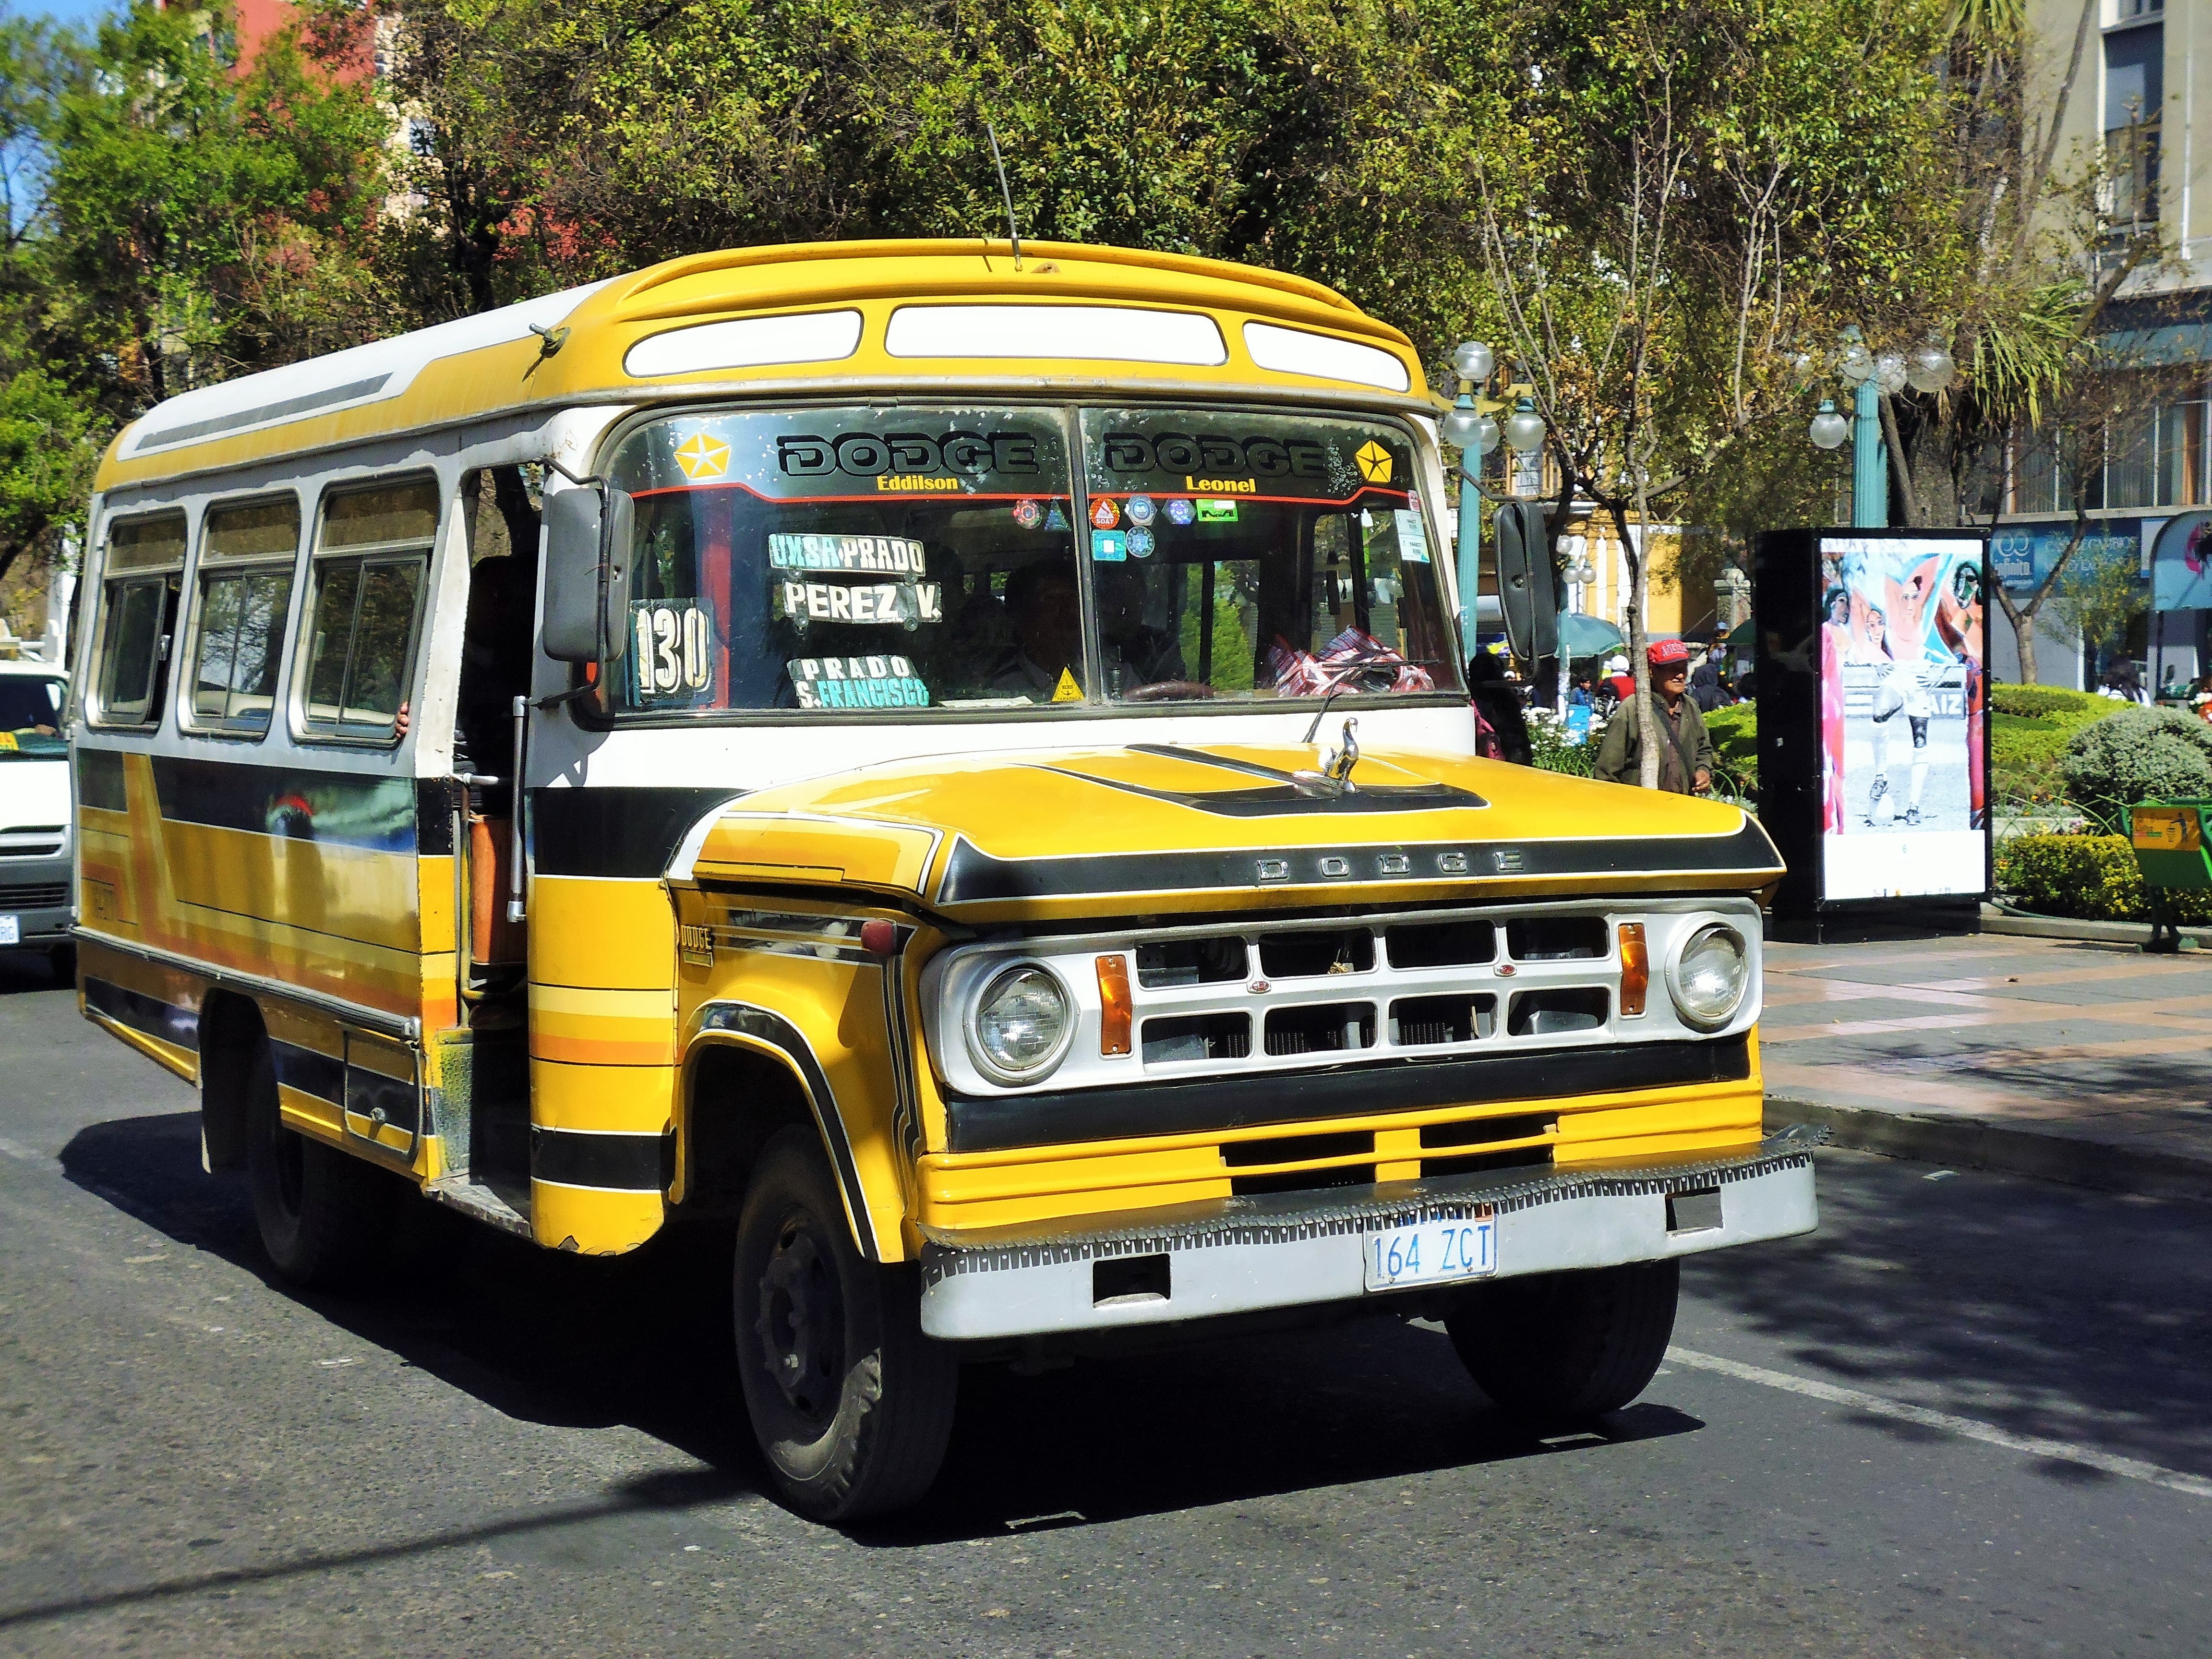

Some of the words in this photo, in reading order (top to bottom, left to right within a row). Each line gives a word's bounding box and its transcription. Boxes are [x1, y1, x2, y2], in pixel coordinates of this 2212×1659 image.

[777, 432, 1040, 476] DODGE
[1104, 432, 1329, 477] DODGE
[877, 476, 958, 491] Eddilson
[1186, 476, 1256, 493] Leonel
[785, 582, 899, 619] PEREZ
[915, 584, 943, 618] V.
[636, 608, 712, 694] 130
[801, 656, 910, 680] PRADO
[1257, 851, 1524, 880] DODGE
[681, 925, 712, 950] DODGE
[1373, 1233, 1420, 1278] 164
[1442, 1225, 1491, 1269] ZCT
